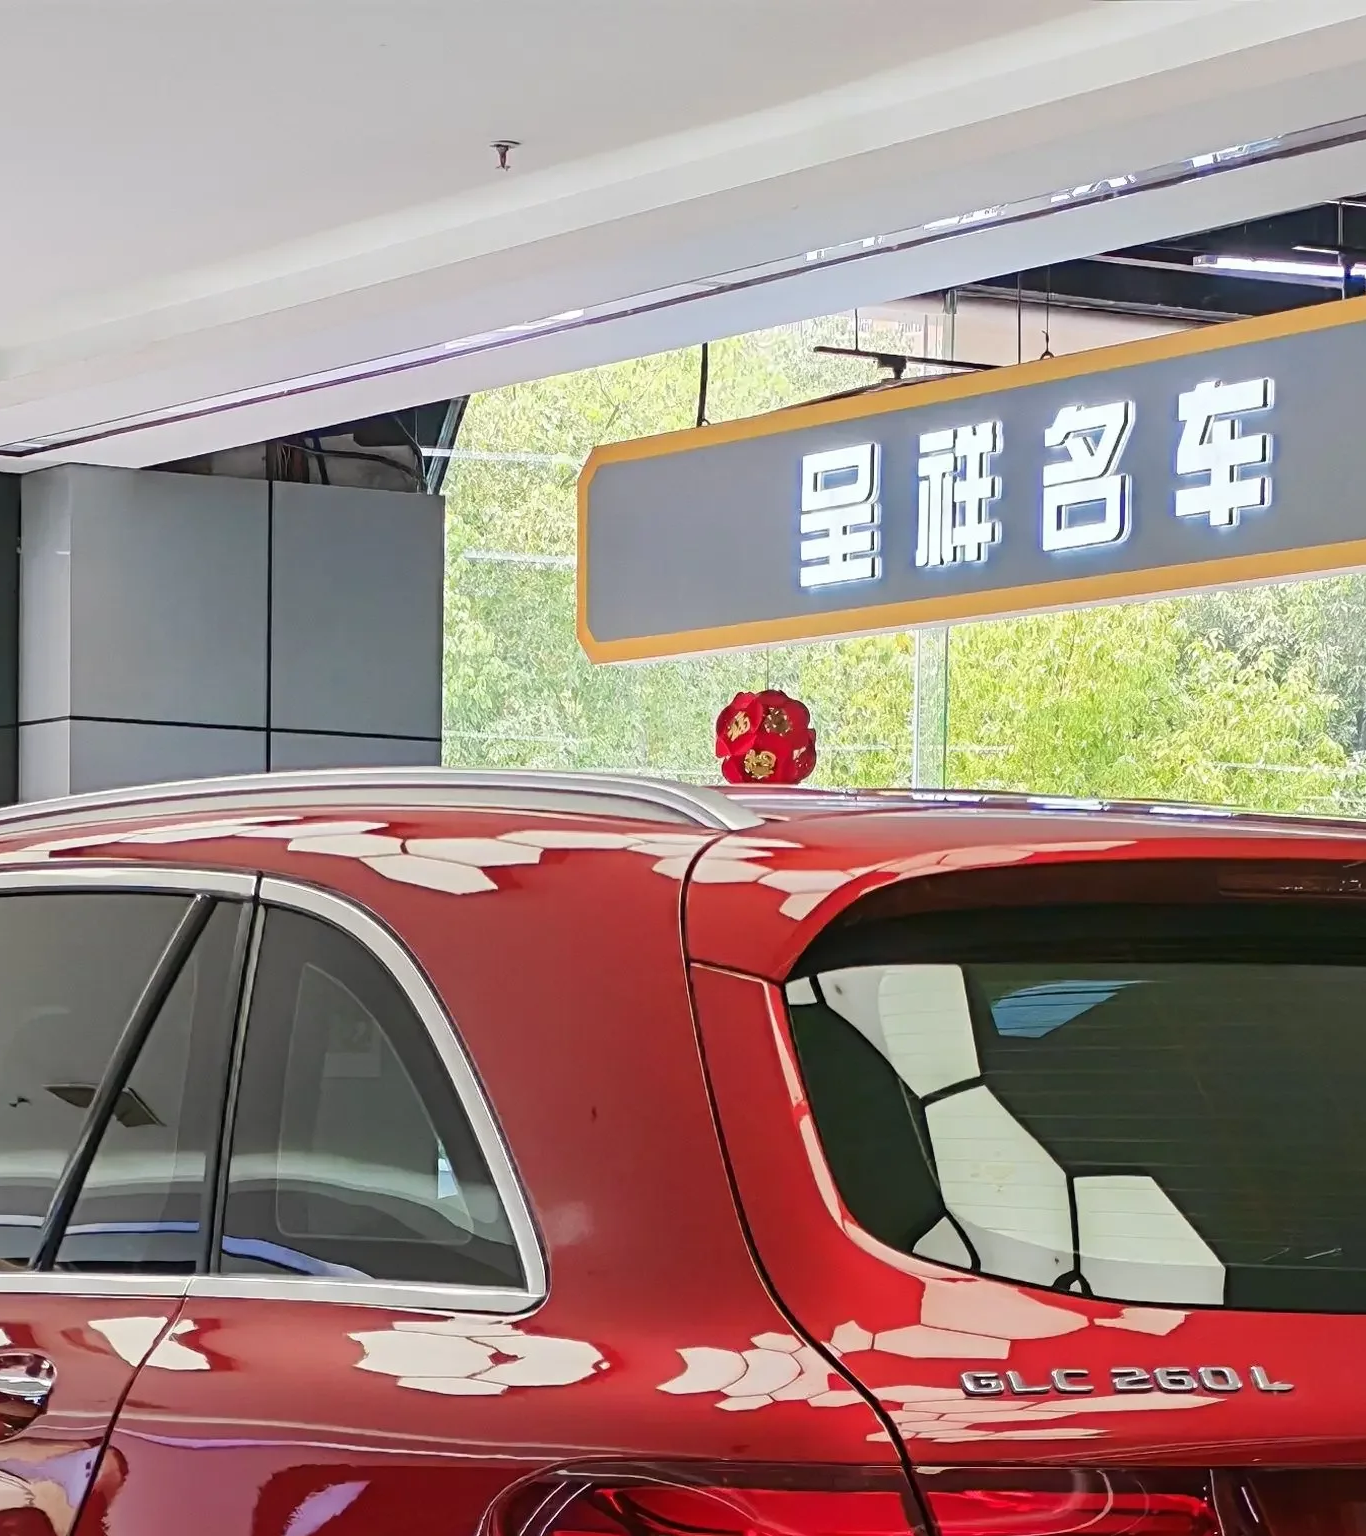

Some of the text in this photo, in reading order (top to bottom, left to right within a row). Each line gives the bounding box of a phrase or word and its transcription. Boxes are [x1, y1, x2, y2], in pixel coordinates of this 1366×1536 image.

[799, 377, 1275, 589] 呈祥名车
[960, 1368, 1094, 1397] GLC
